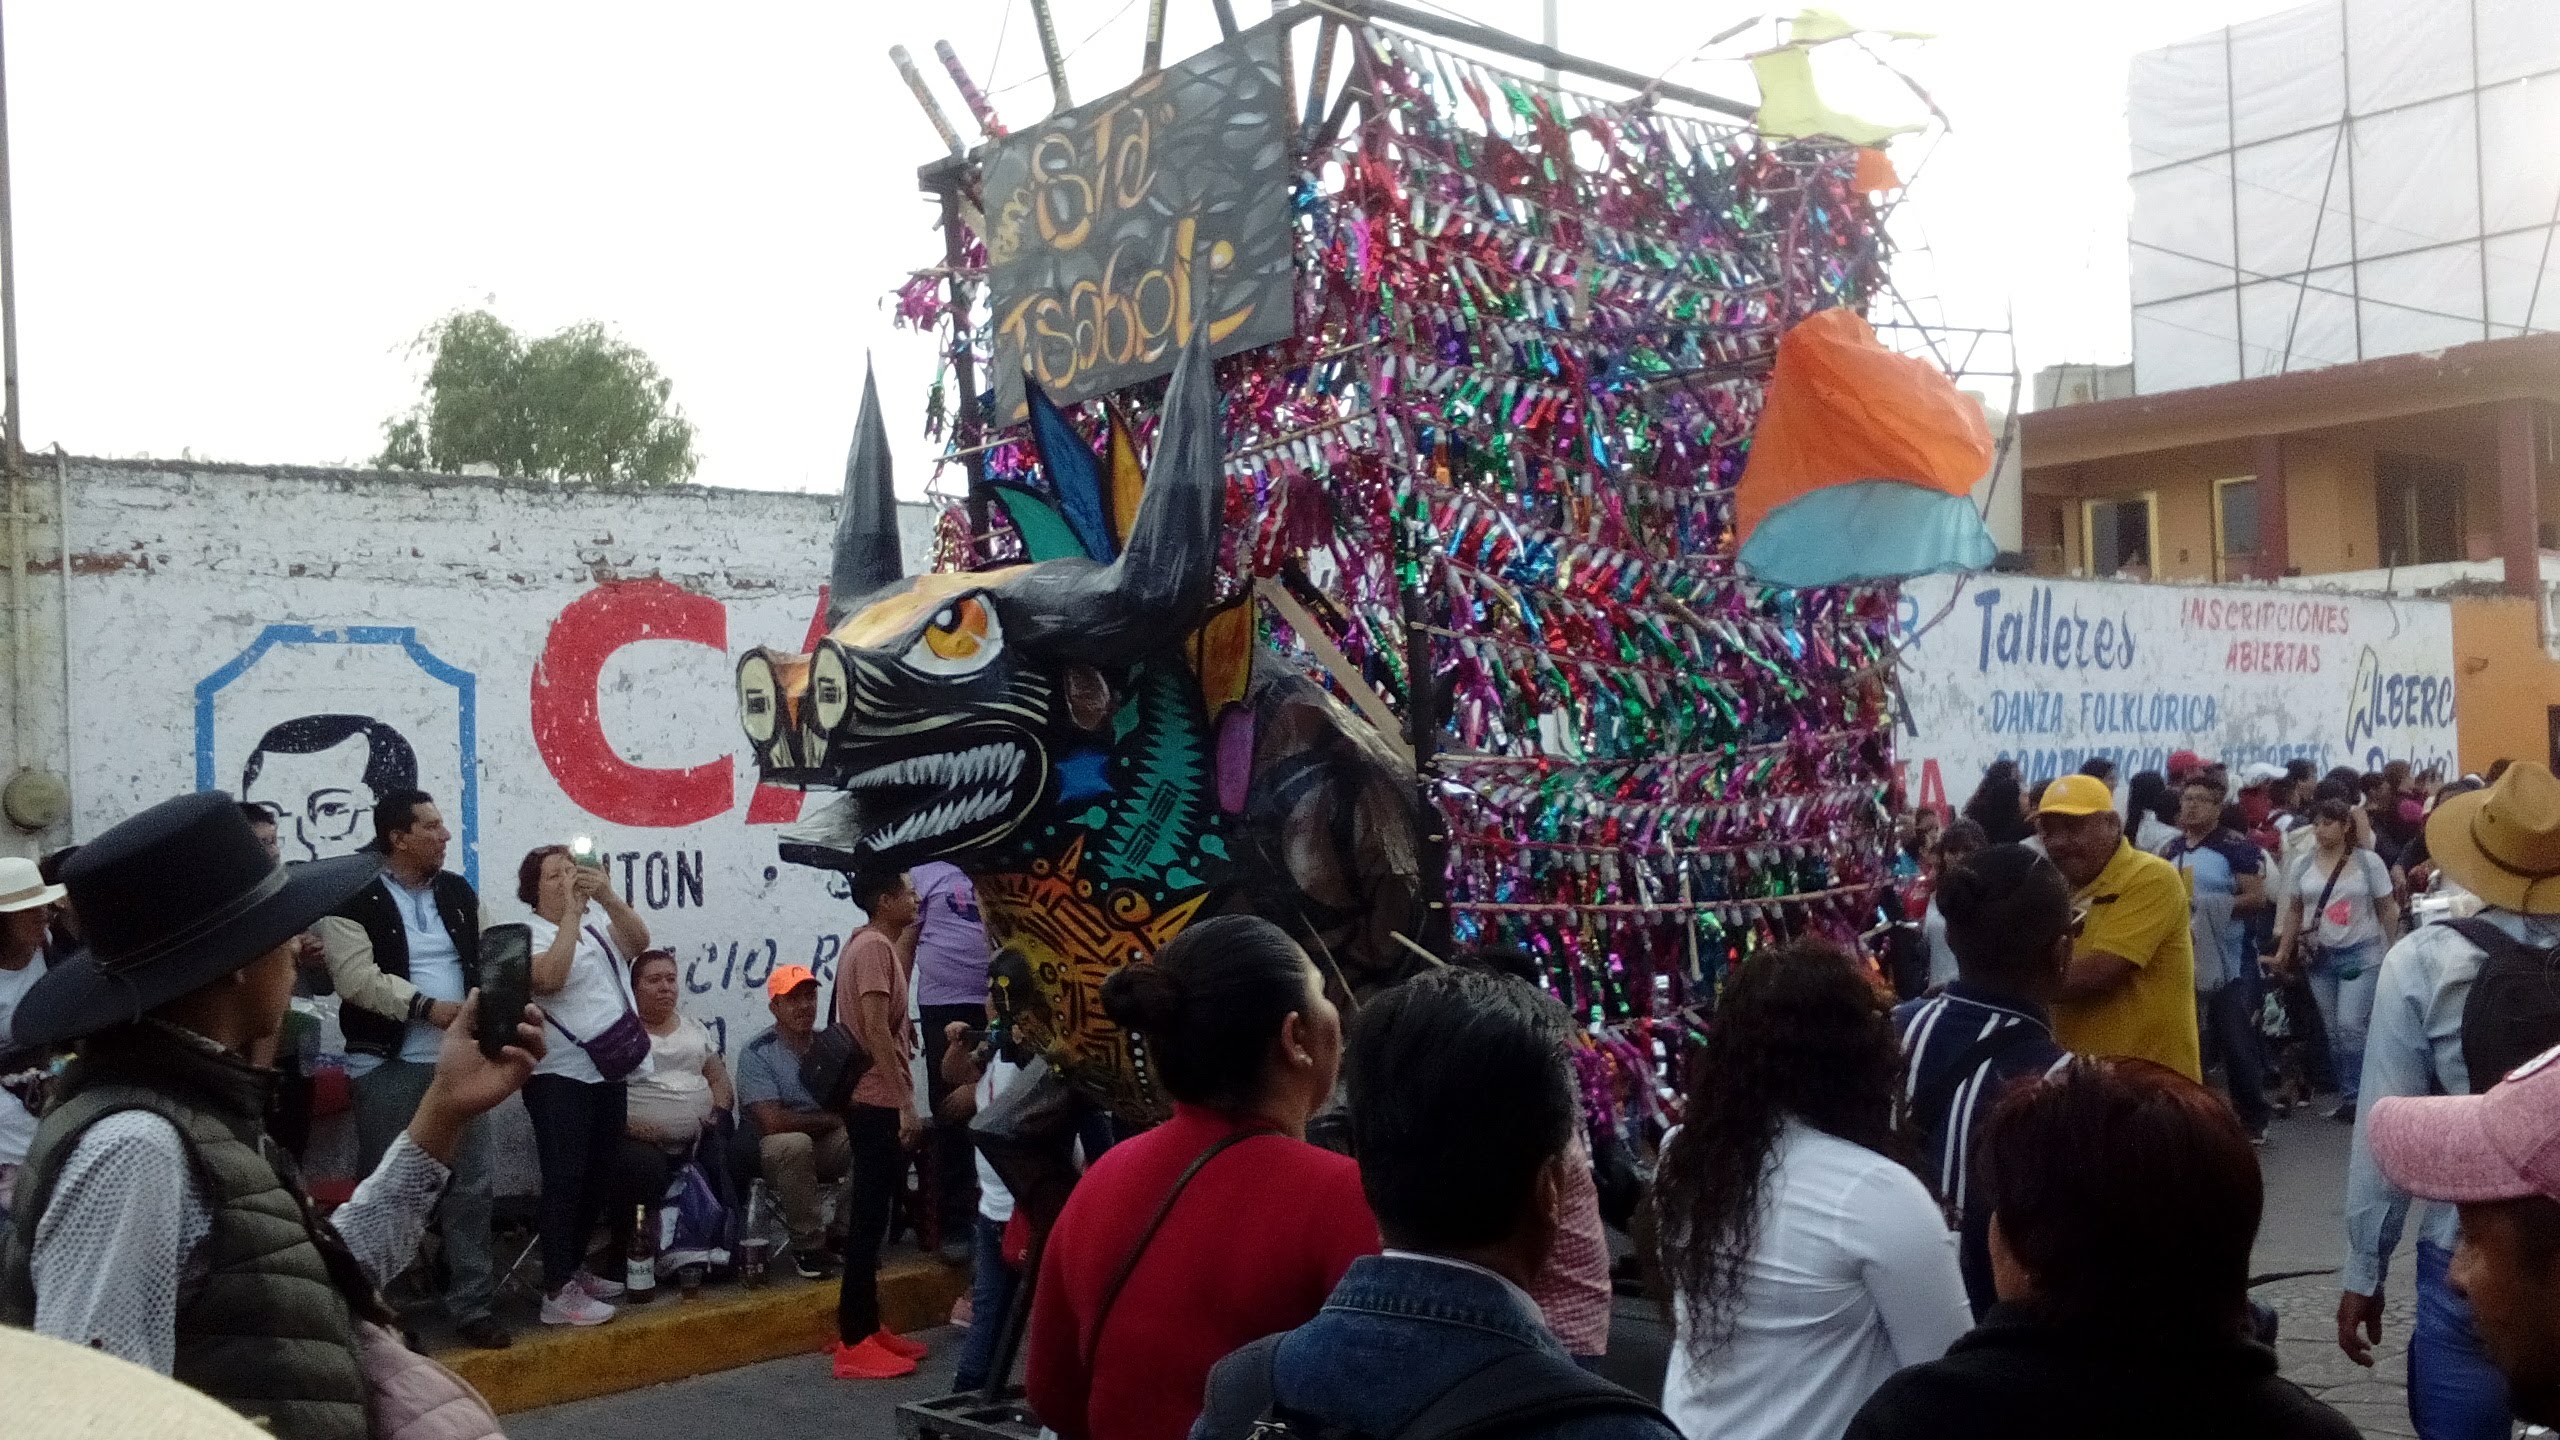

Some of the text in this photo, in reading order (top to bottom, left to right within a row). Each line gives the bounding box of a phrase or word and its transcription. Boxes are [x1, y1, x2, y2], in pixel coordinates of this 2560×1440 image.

[1974, 585, 2136, 673] Talleres
[2180, 597, 2350, 635] INSCRIPCIONES
[2224, 640, 2321, 674] ABIERTAS
[1991, 690, 2064, 734] DANZA
